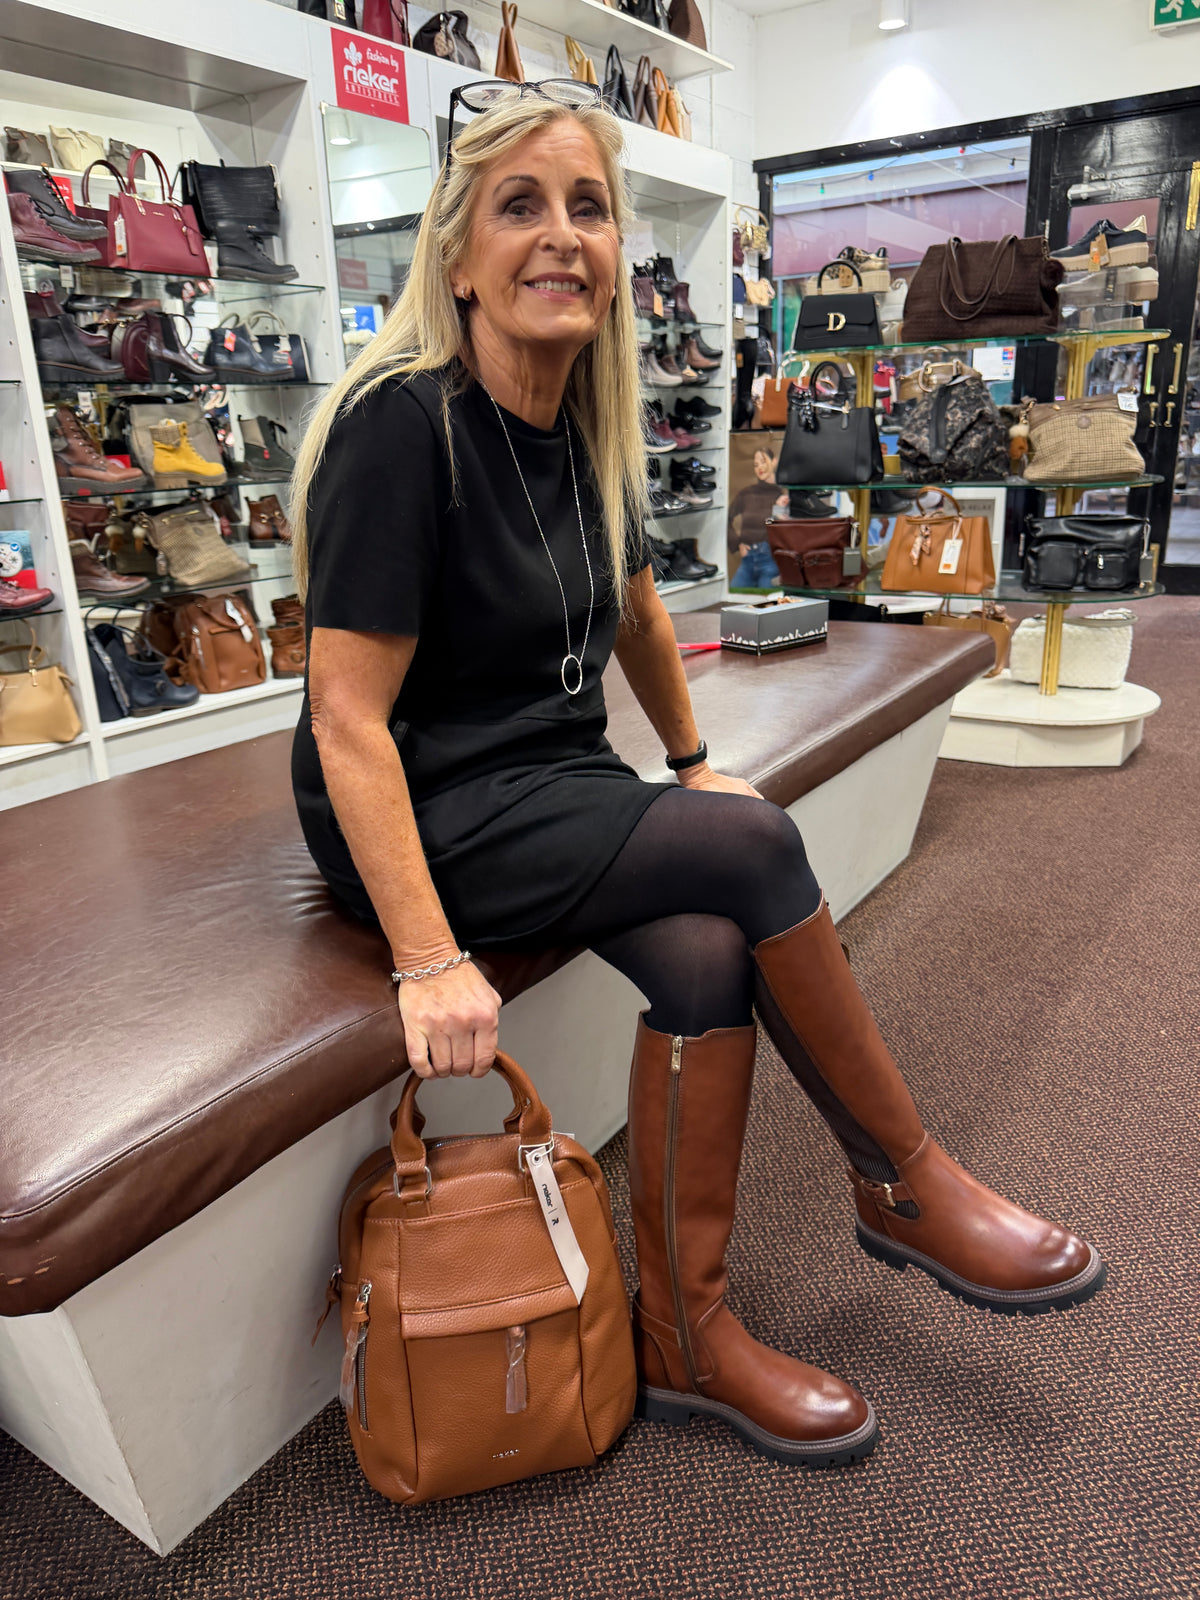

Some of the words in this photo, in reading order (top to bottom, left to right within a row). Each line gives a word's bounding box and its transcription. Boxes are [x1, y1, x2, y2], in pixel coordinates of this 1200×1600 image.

[366, 48, 390, 65] fashion
[390, 54, 399, 73] by
[343, 64, 399, 93] rieker
[826, 312, 846, 332] D
